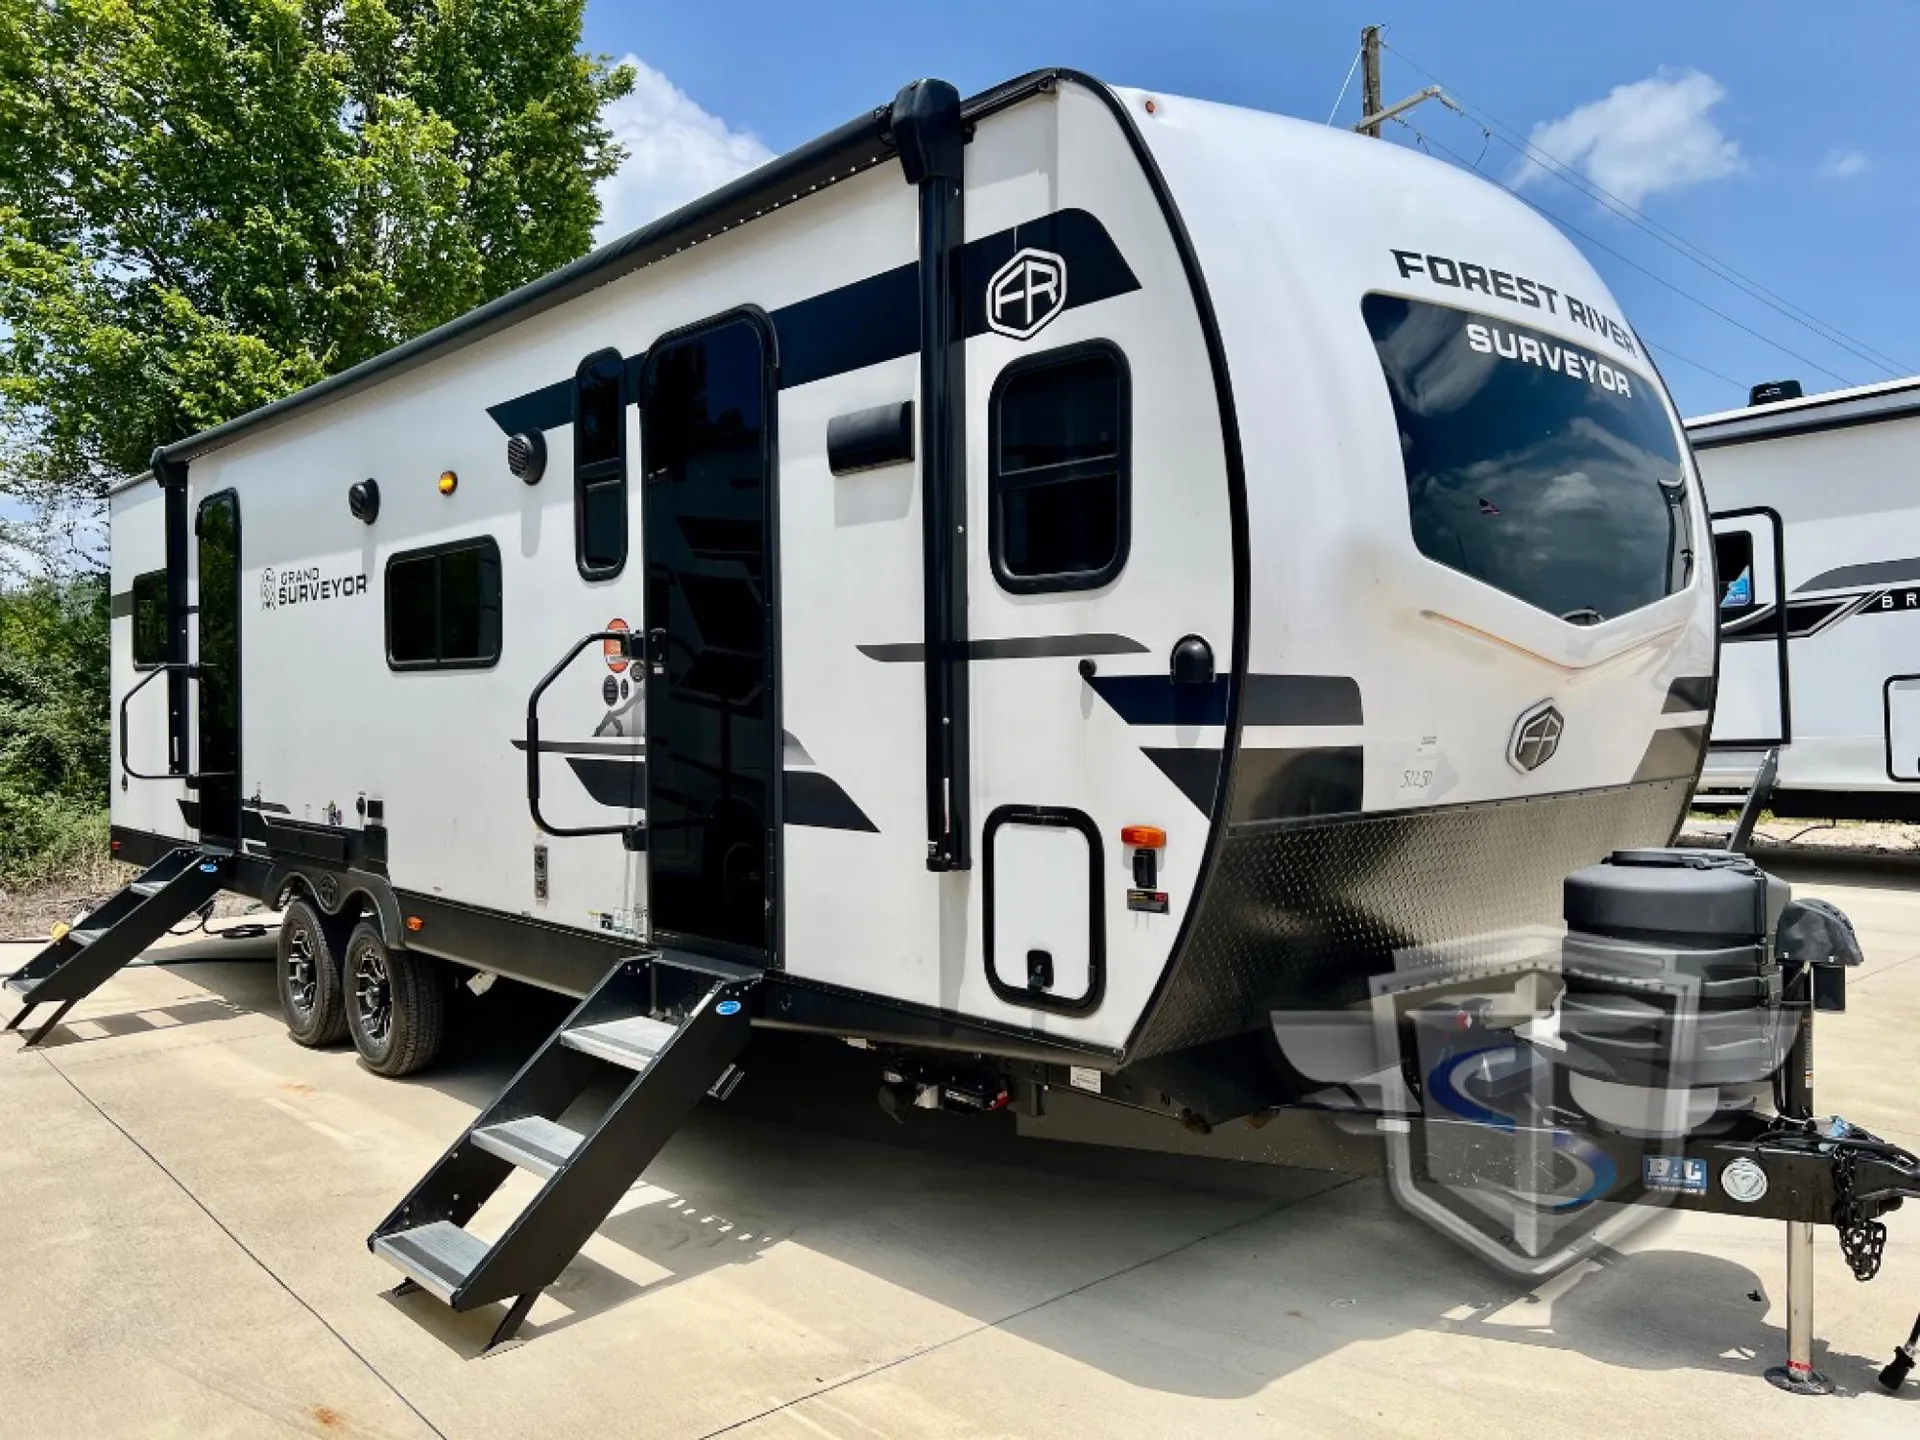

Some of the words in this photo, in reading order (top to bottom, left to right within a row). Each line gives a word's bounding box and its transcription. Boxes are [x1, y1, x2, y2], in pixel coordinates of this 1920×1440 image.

[1390, 249, 1559, 314] FOREST
[1564, 294, 1638, 359] RIVER
[1466, 323, 1632, 398] SURVEYOR
[278, 573, 367, 606] SURVEYOR
[280, 567, 320, 586] GRAND
